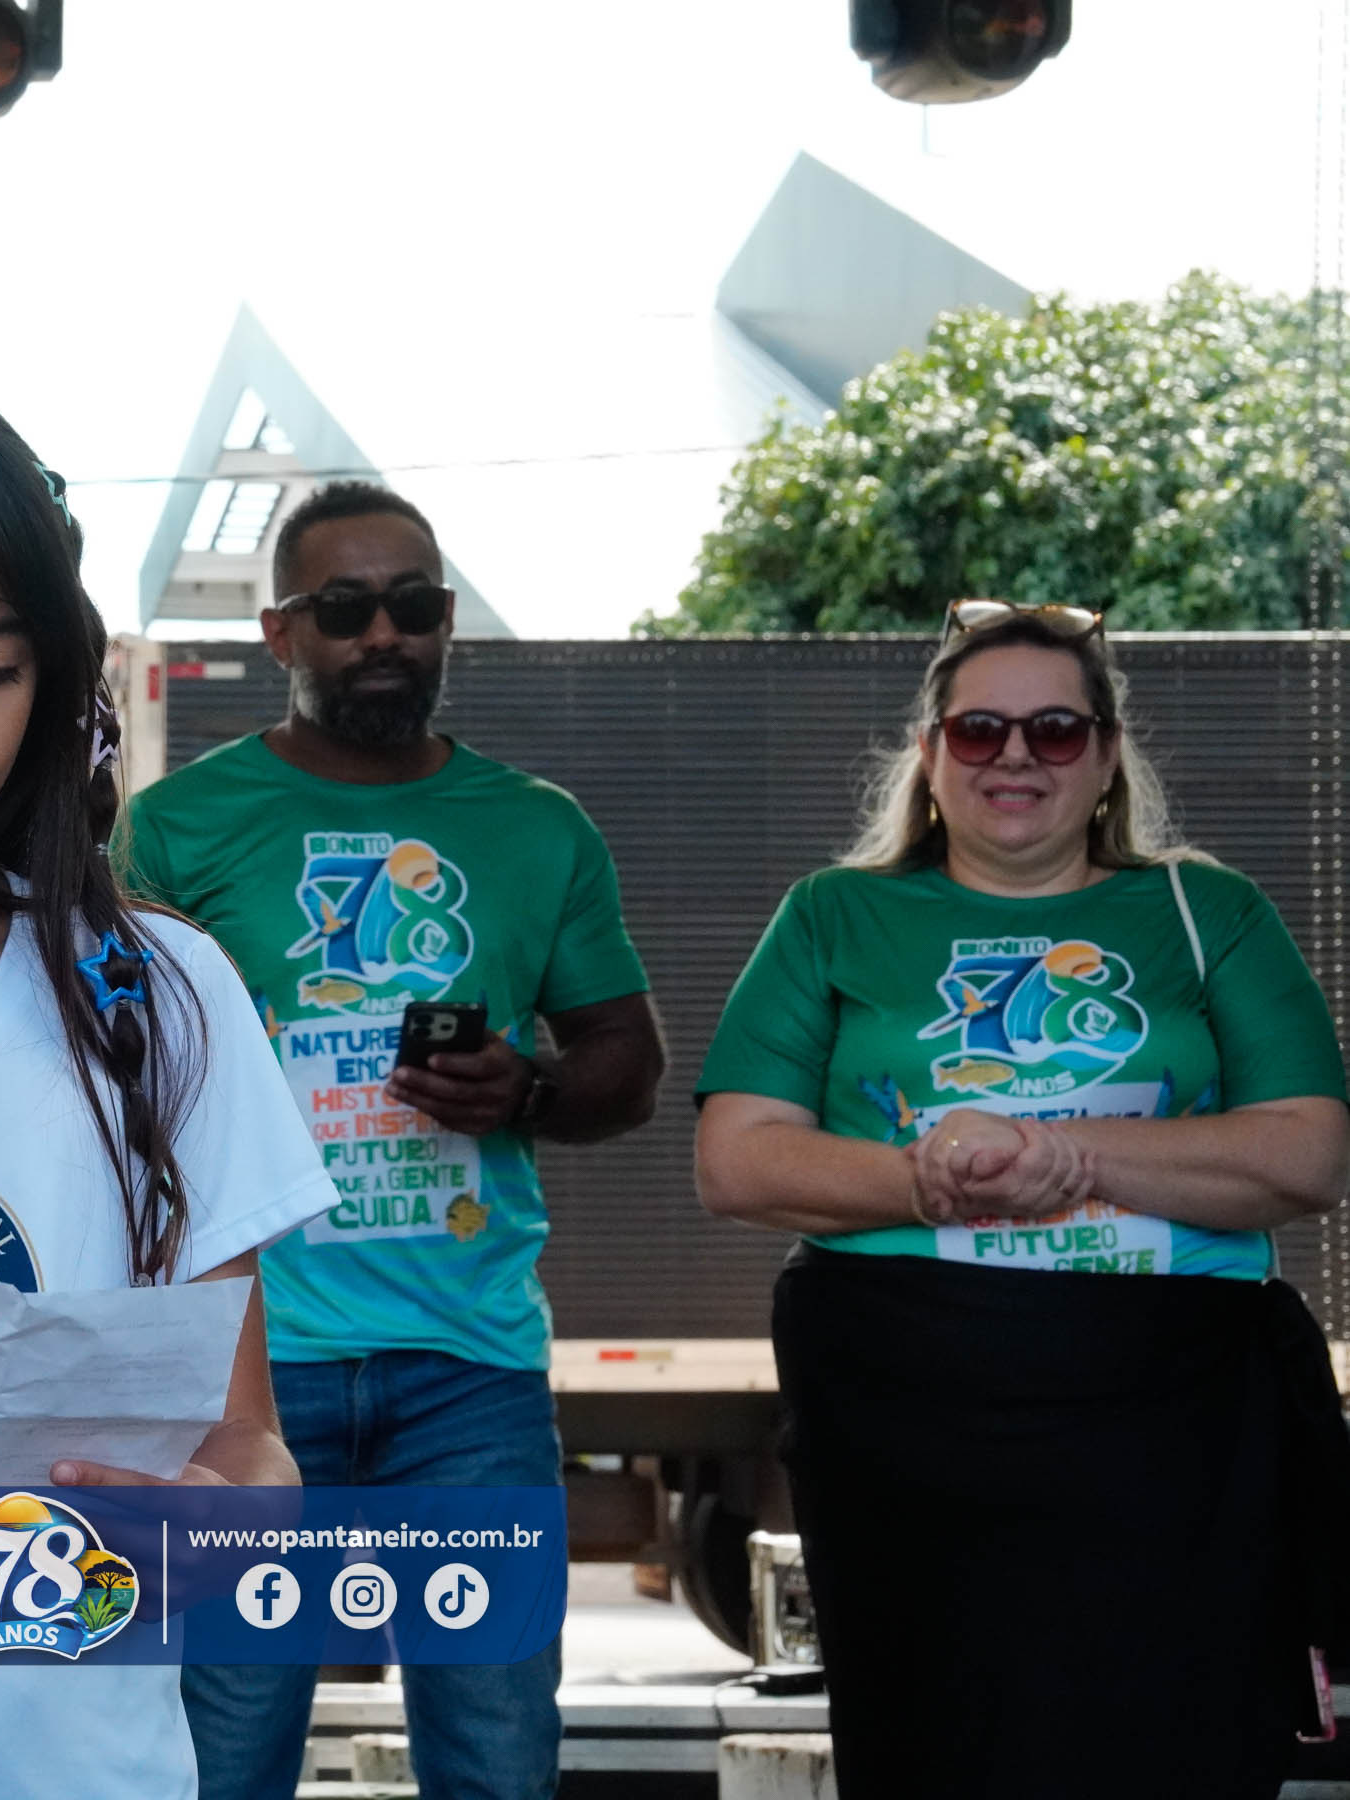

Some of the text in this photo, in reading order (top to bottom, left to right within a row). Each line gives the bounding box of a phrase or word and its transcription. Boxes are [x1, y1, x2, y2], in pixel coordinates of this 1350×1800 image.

[310, 835, 388, 855] BONITO
[956, 941, 1048, 956] BONITO
[291, 1026, 402, 1058] NATURE
[1008, 1073, 1077, 1095] ANOS
[314, 1120, 349, 1141] QUE
[323, 1137, 439, 1167] FUTURO
[374, 1176, 384, 1190] A
[388, 1164, 466, 1190] GENTE
[974, 1223, 1118, 1258] FUTURO
